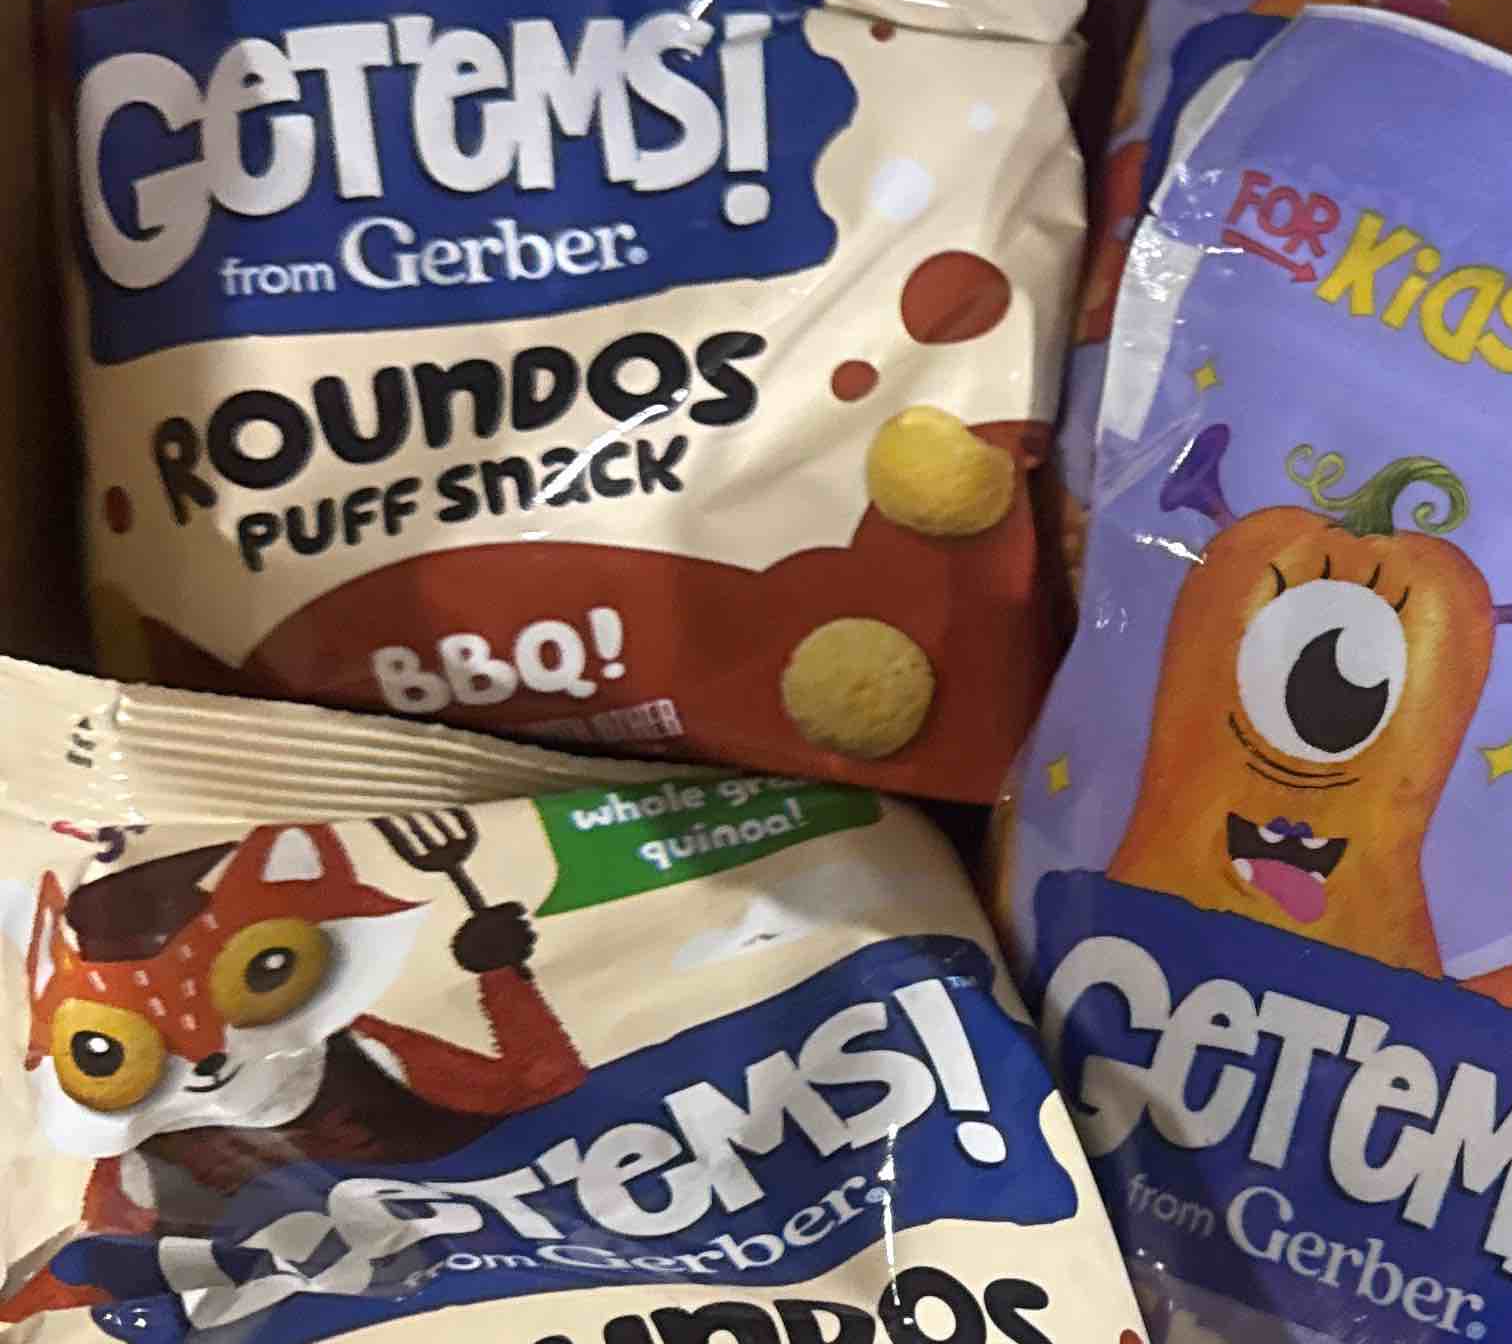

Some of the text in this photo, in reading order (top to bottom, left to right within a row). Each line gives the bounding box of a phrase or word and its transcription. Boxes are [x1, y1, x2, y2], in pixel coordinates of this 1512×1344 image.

[221, 258, 336, 296] from
[238, 476, 421, 572] PUFF
[371, 606, 627, 714] BBQ!
[570, 783, 711, 832] whole
[638, 806, 806, 869] quinoa!
[1125, 1174, 1217, 1238] from
